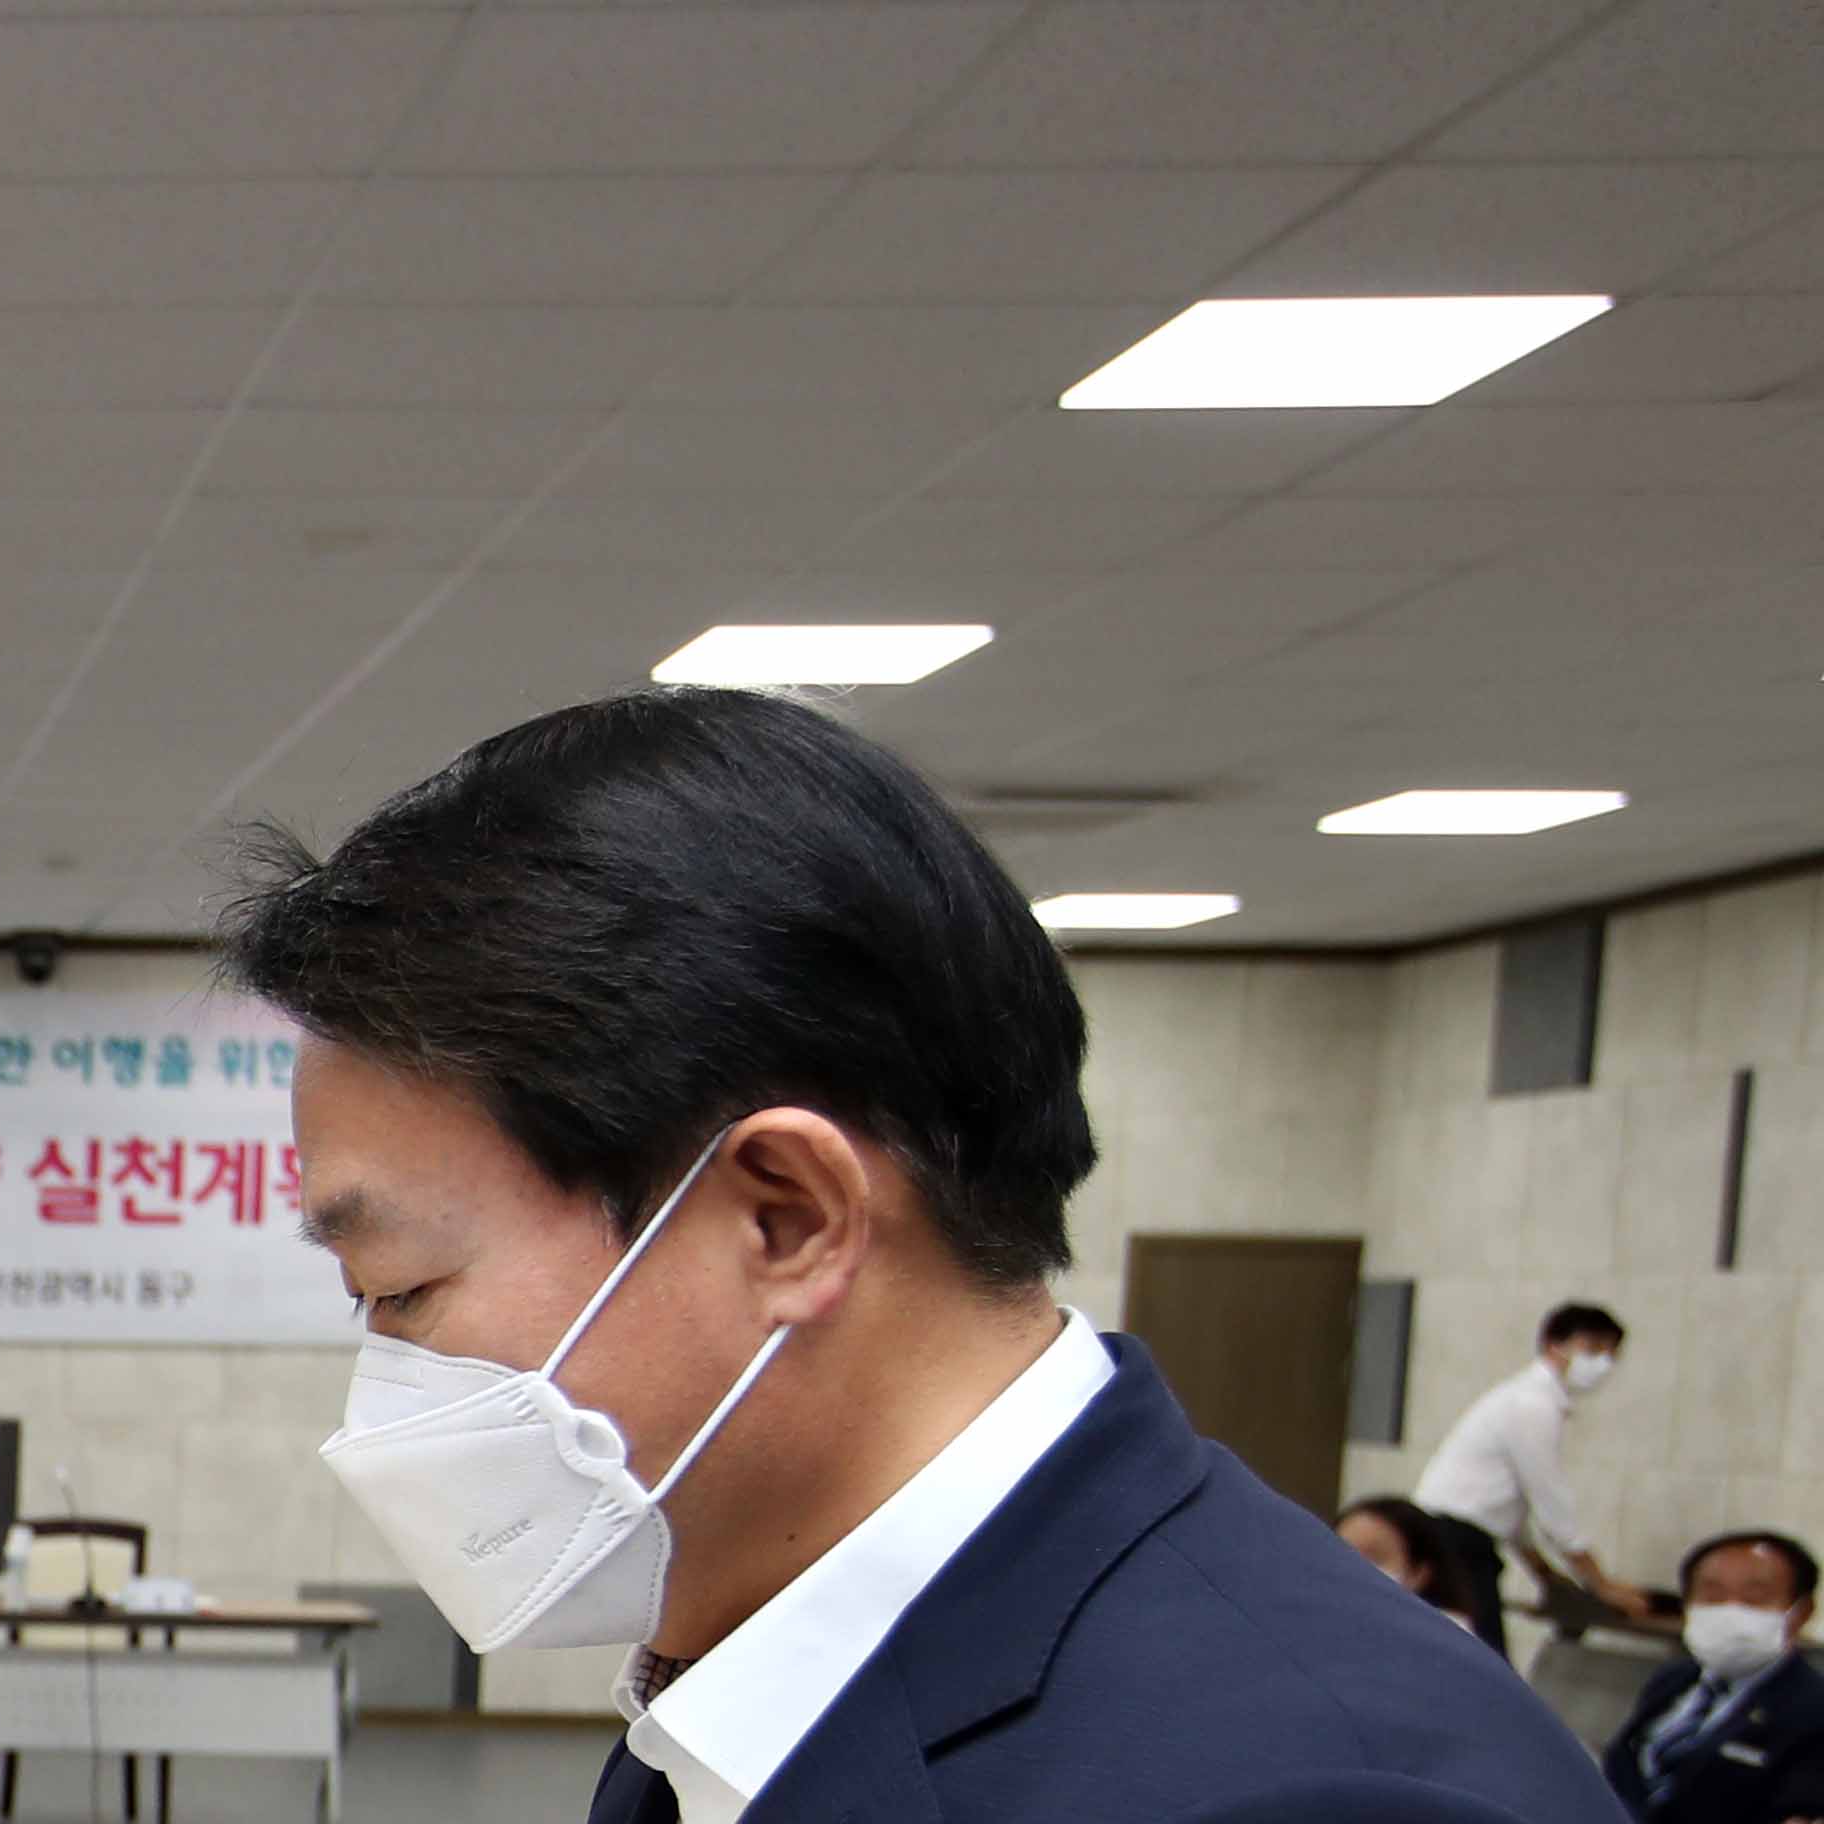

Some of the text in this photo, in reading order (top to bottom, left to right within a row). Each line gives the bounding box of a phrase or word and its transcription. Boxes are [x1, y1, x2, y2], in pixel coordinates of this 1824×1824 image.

[53, 1035, 194, 1088] 이행을
[137, 1271, 196, 1309] 동구
[459, 1518, 534, 1562] Nepure
